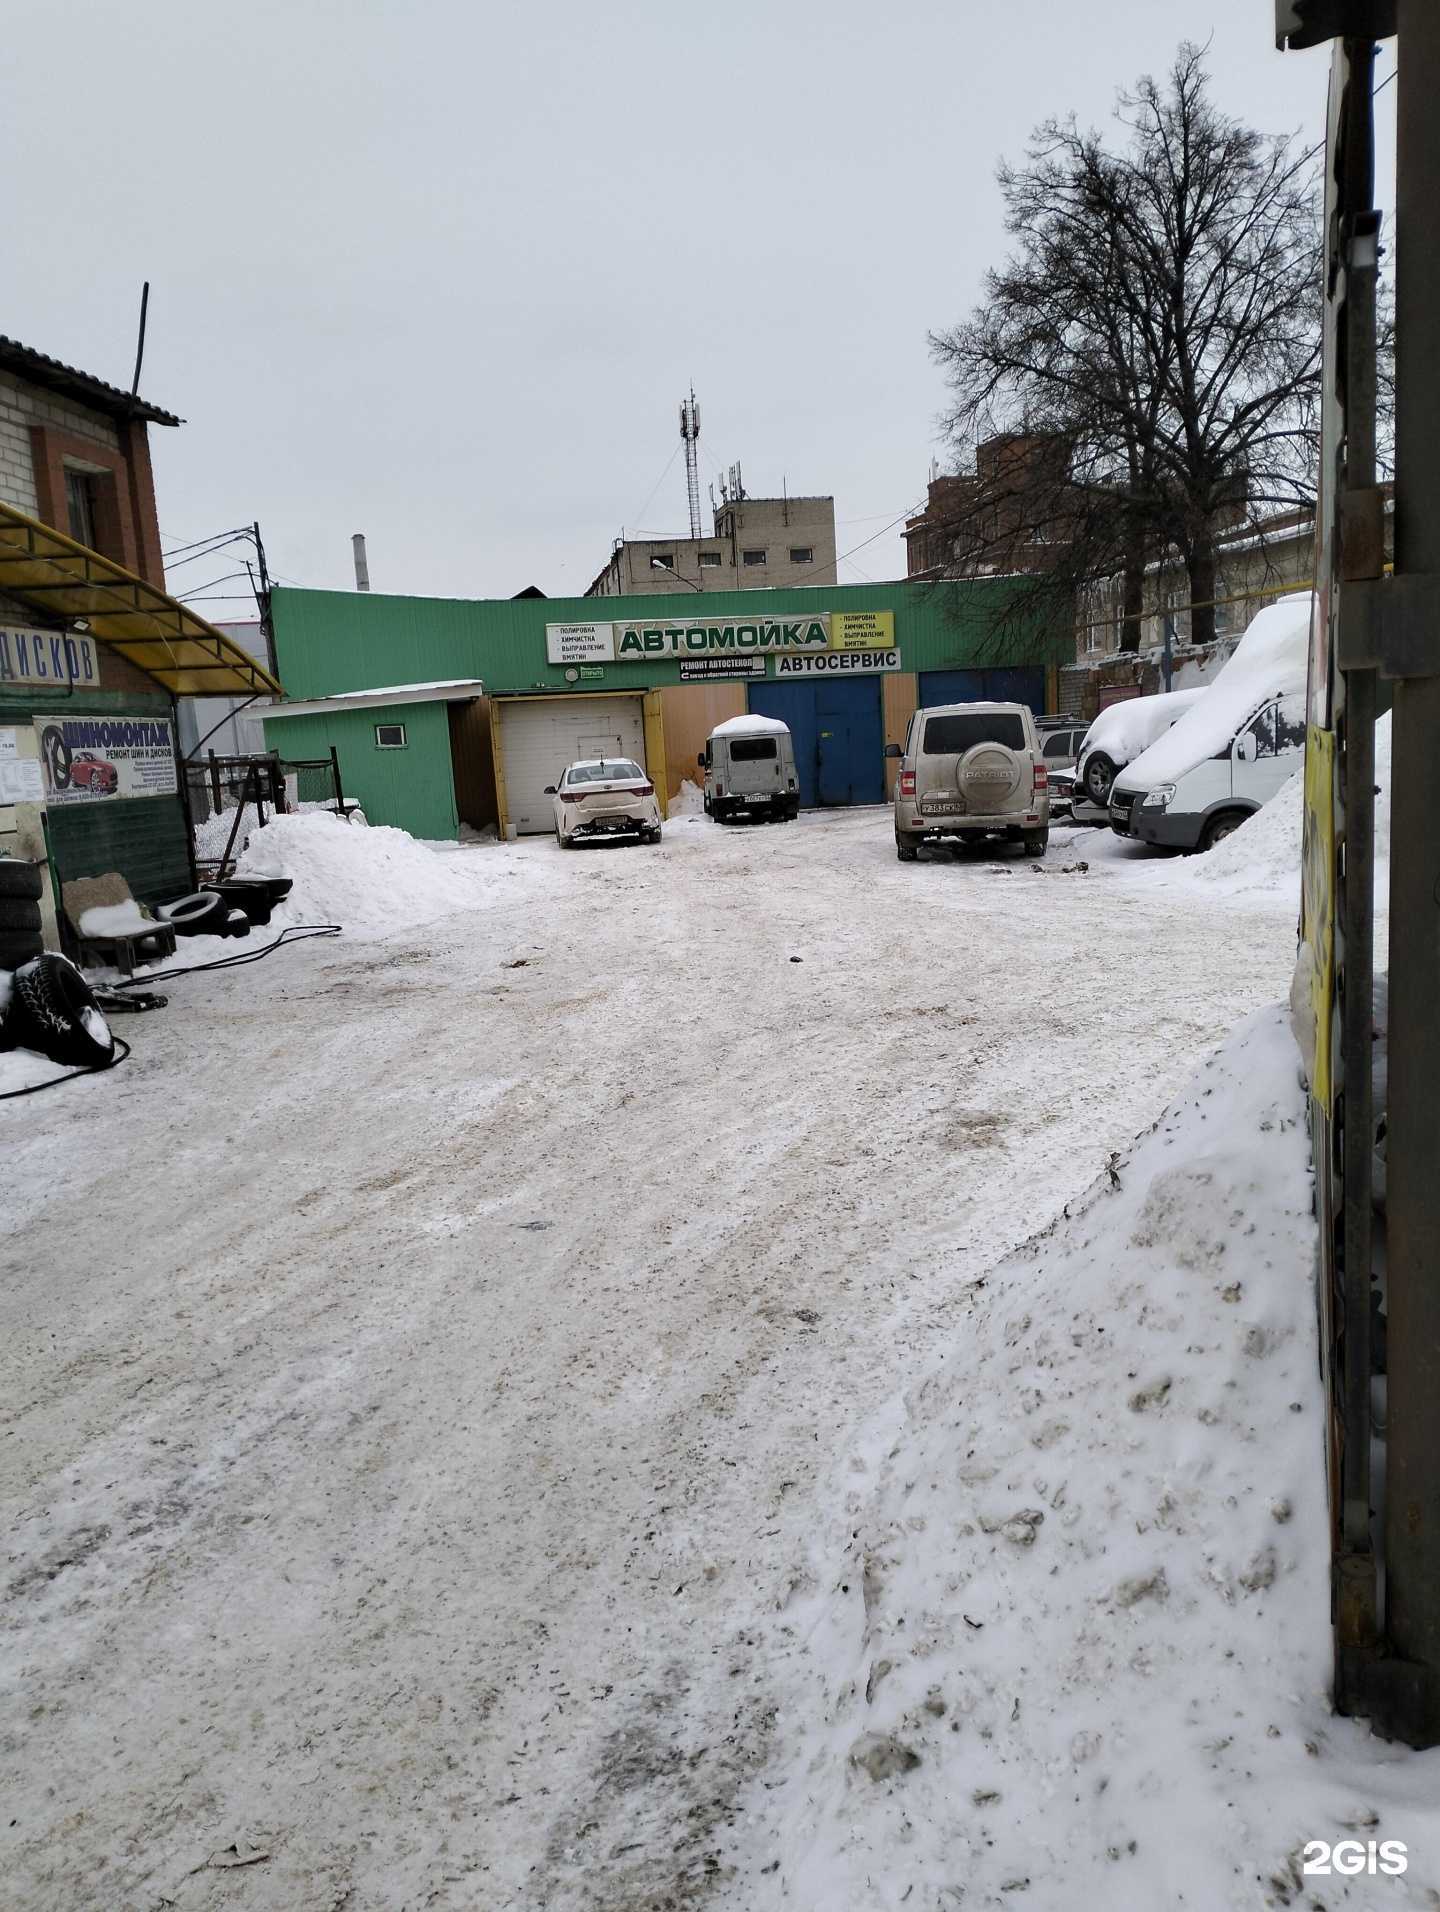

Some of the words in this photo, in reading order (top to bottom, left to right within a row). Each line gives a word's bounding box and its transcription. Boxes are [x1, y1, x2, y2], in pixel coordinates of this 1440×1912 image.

[843, 614, 876, 622] ПОЛИРОВКА
[560, 626, 595, 634] ПОЛИРОВКА
[844, 630, 884, 639] ВЫПРАВЛЕНИЕ
[561, 635, 595, 643] ХИМЧИСТКА
[619, 620, 828, 652] АВТОМОЙКА
[561, 643, 605, 652] ВЫПРАВЛЕНИЕ
[0, 632, 93, 680] ДИСКОВ
[680, 660, 708, 670] РЕМОНТ
[708, 658, 753, 669] АВТОСТЕКОЛ
[780, 652, 897, 672] АВТОСЕРВИС
[62, 721, 171, 748] ШИНОМОНТАЖ
[106, 749, 130, 760] РЕМОНТ
